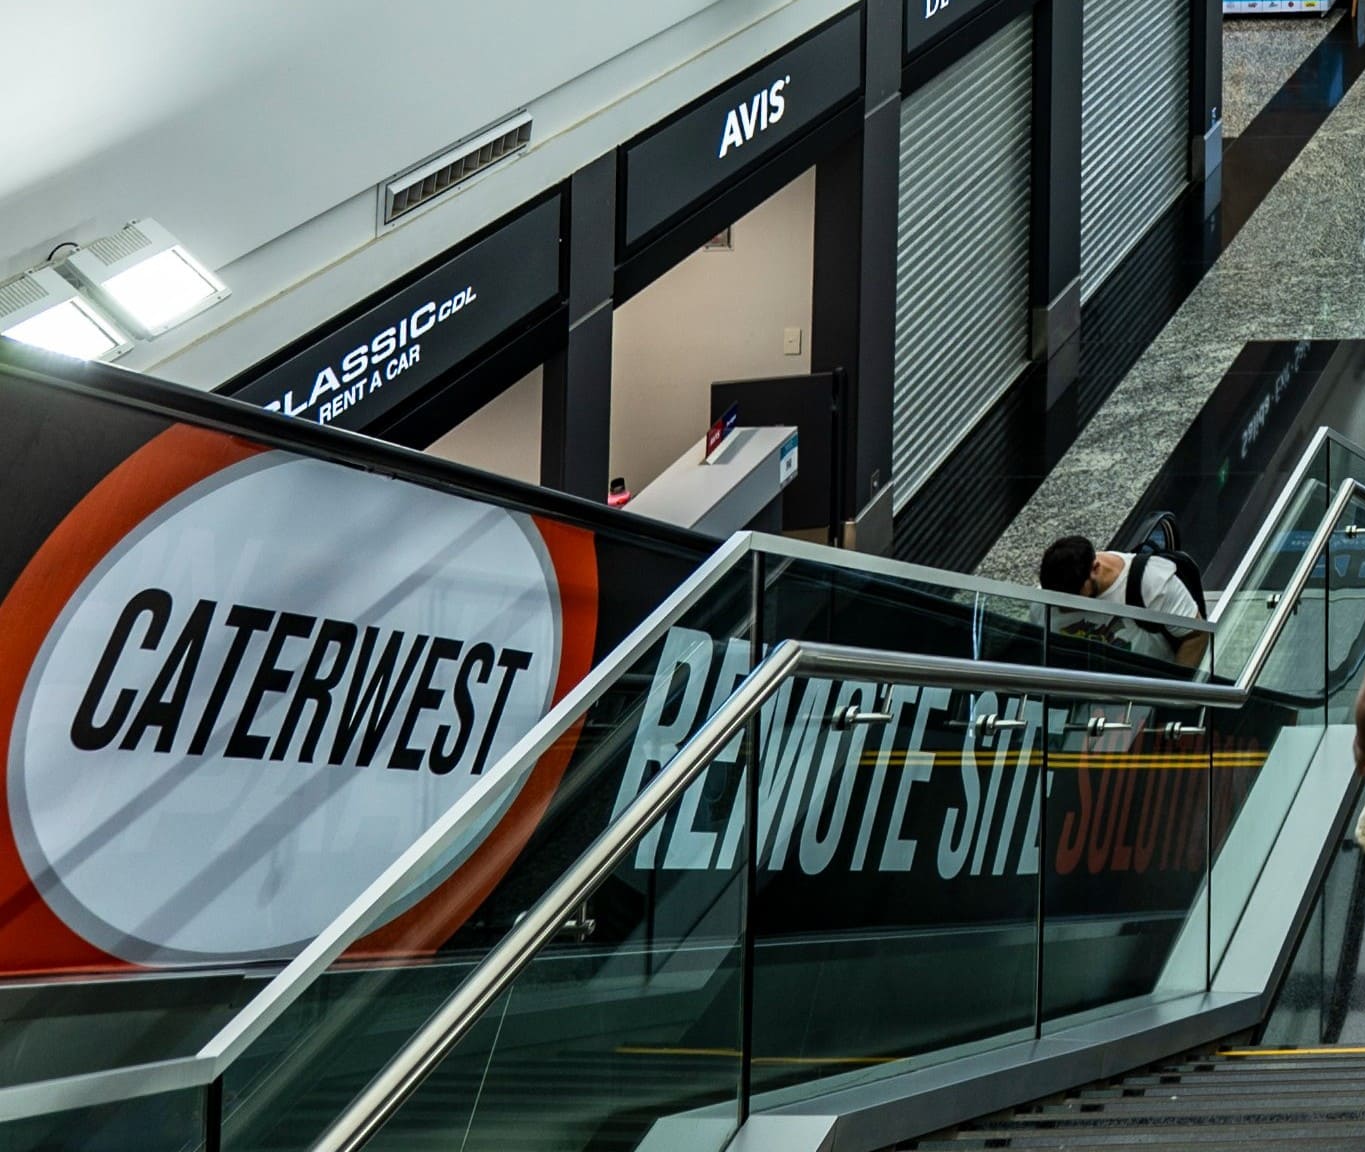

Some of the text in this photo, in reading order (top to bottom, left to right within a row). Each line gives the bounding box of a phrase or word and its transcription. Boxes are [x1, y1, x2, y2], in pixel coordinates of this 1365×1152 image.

[718, 79, 785, 159] AVIS
[263, 286, 477, 417] LASSIC CDL
[319, 343, 421, 425] RENT A CAR
[70, 587, 533, 776] CATERWEST
[608, 625, 953, 876] REMOTE
[936, 690, 1070, 881] SITE
